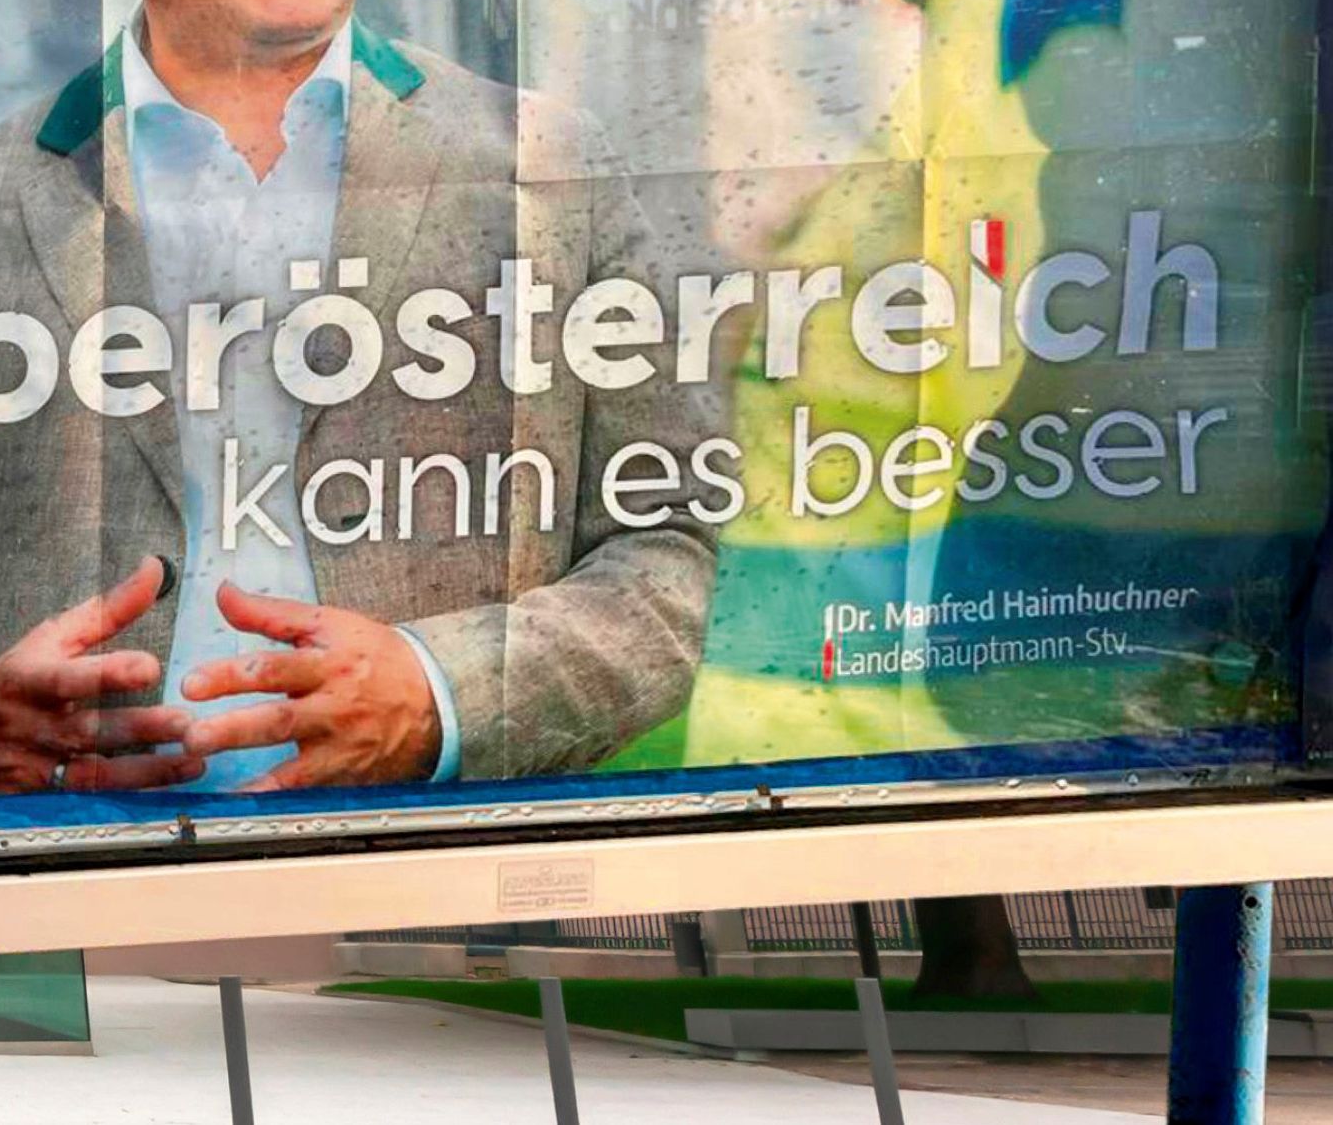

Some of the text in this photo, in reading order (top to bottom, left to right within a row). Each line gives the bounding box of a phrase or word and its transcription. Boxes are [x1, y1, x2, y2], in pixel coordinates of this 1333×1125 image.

[220, 406, 1229, 551] kann es besser
[837, 581, 1195, 633] Dr. Manfred Haimbuchner
[837, 627, 1133, 677] Landeshauptmann-Stv.
